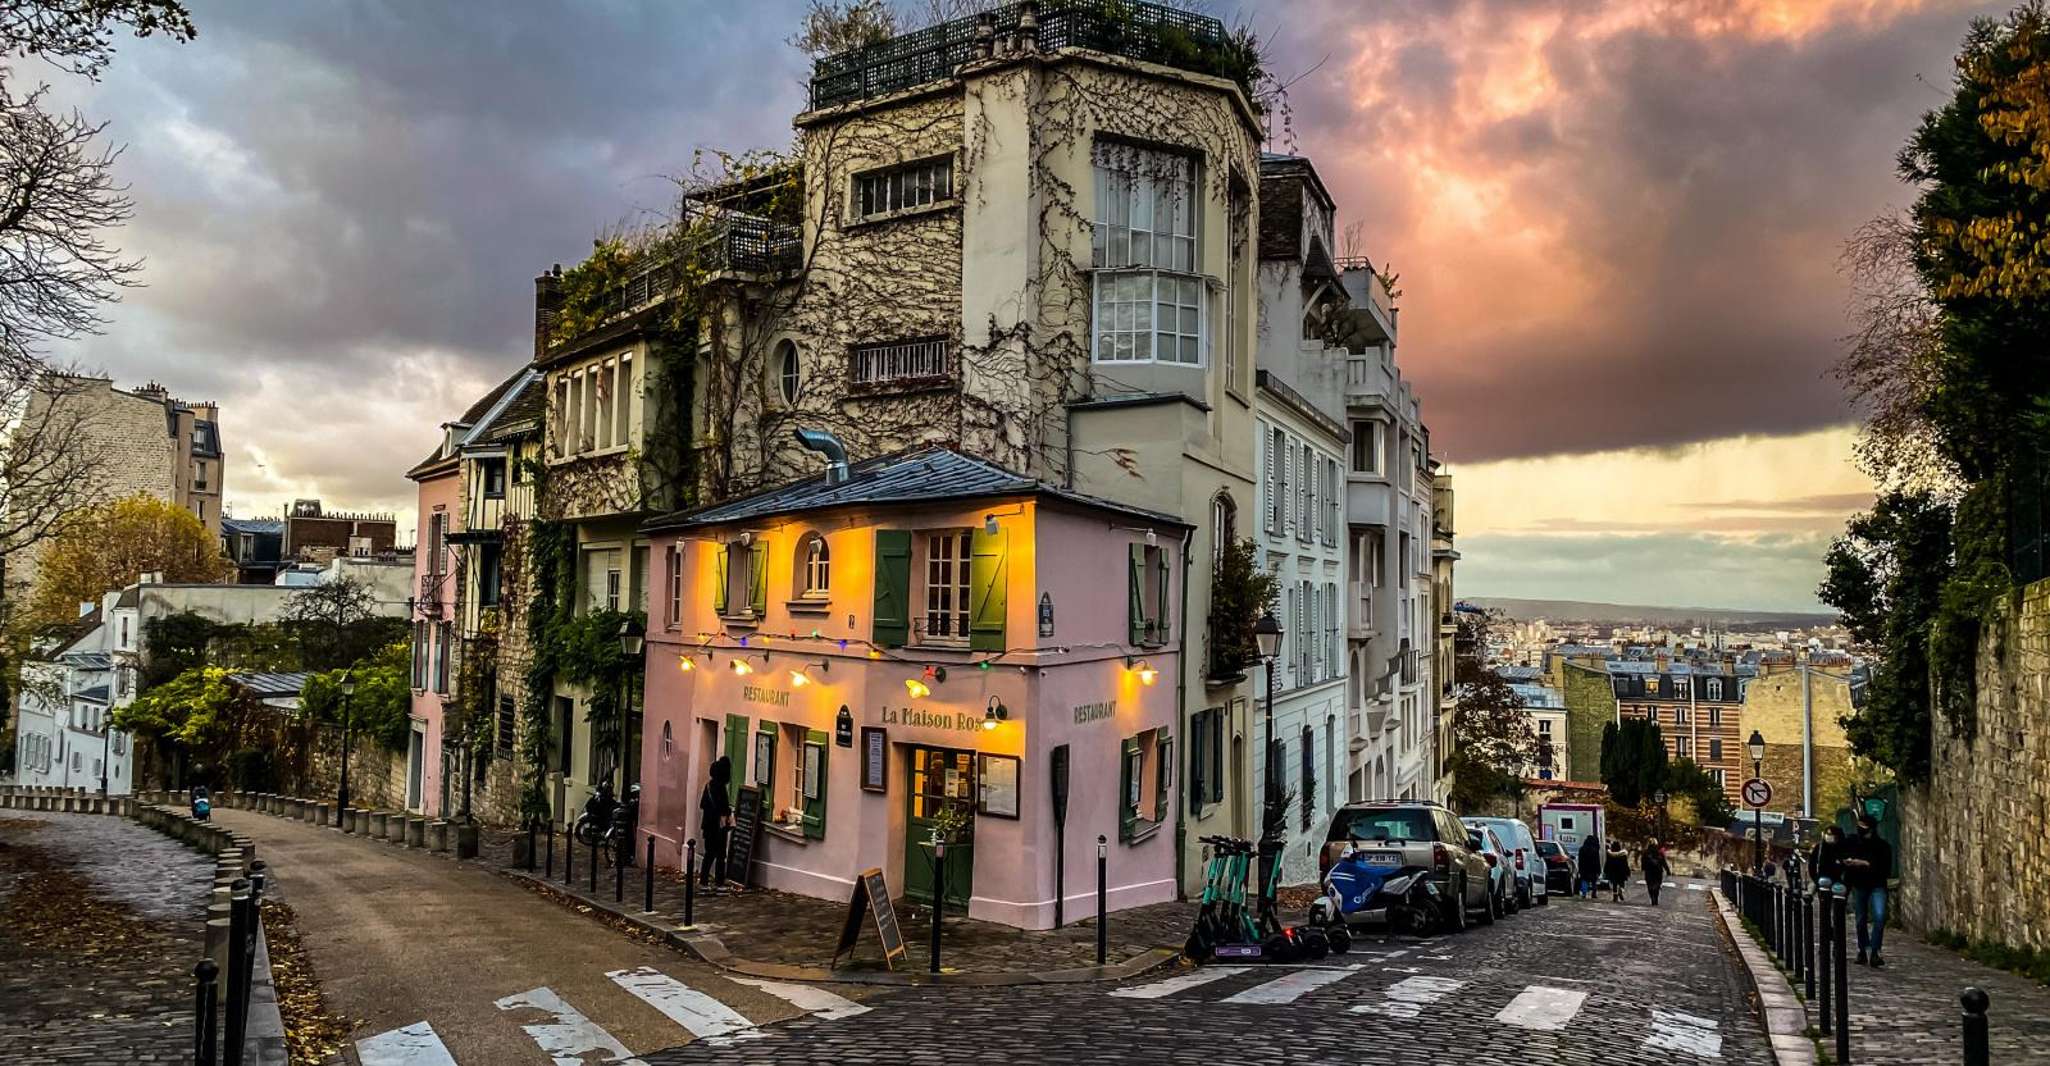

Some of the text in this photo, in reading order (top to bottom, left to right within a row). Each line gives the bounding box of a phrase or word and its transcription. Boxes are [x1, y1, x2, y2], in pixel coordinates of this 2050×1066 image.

[743, 685, 790, 707] RESTAURANT
[881, 706, 897, 724] La
[902, 707, 952, 729] Maison
[1074, 700, 1117, 725] RESTAURANT
